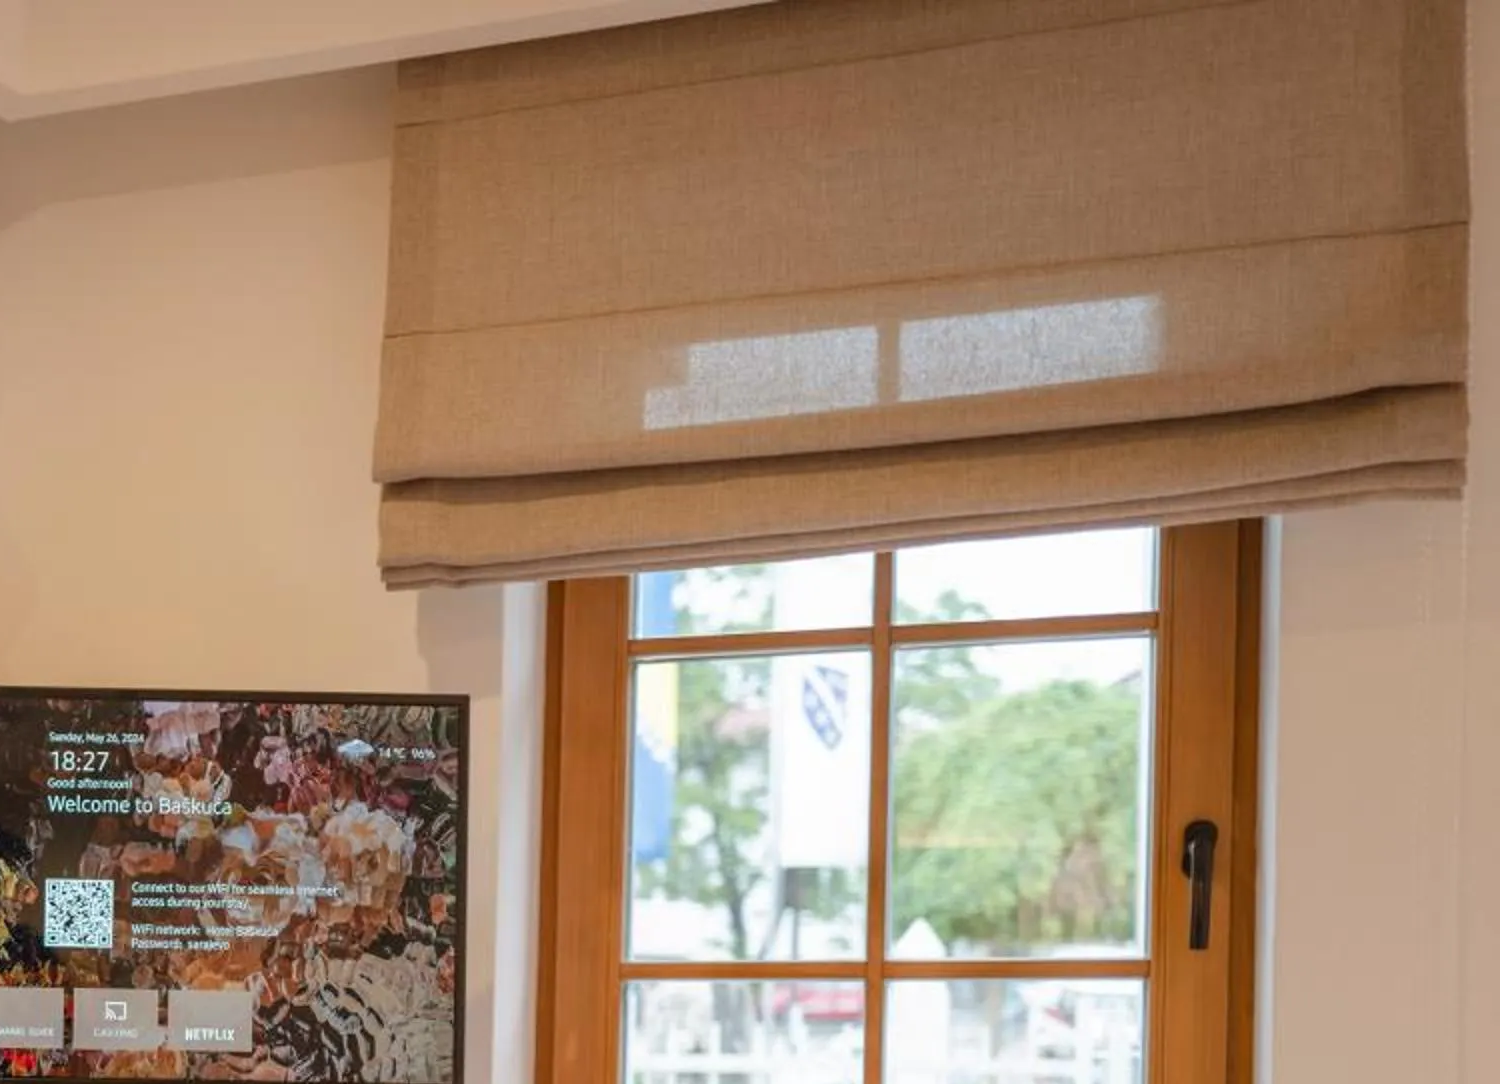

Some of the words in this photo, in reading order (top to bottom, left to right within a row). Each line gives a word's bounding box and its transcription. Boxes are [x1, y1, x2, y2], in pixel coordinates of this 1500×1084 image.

[49, 731, 84, 743] Sunday,
[86, 731, 105, 744] May
[51, 751, 109, 772] 18:27
[47, 777, 76, 788] Good
[48, 795, 131, 814] Welcome
[135, 798, 153, 814] to
[131, 881, 173, 893] Connect
[175, 883, 187, 893] to
[189, 885, 206, 893] our
[131, 898, 164, 908] access
[167, 897, 199, 910] during
[185, 1027, 235, 1041] NETFLIX
